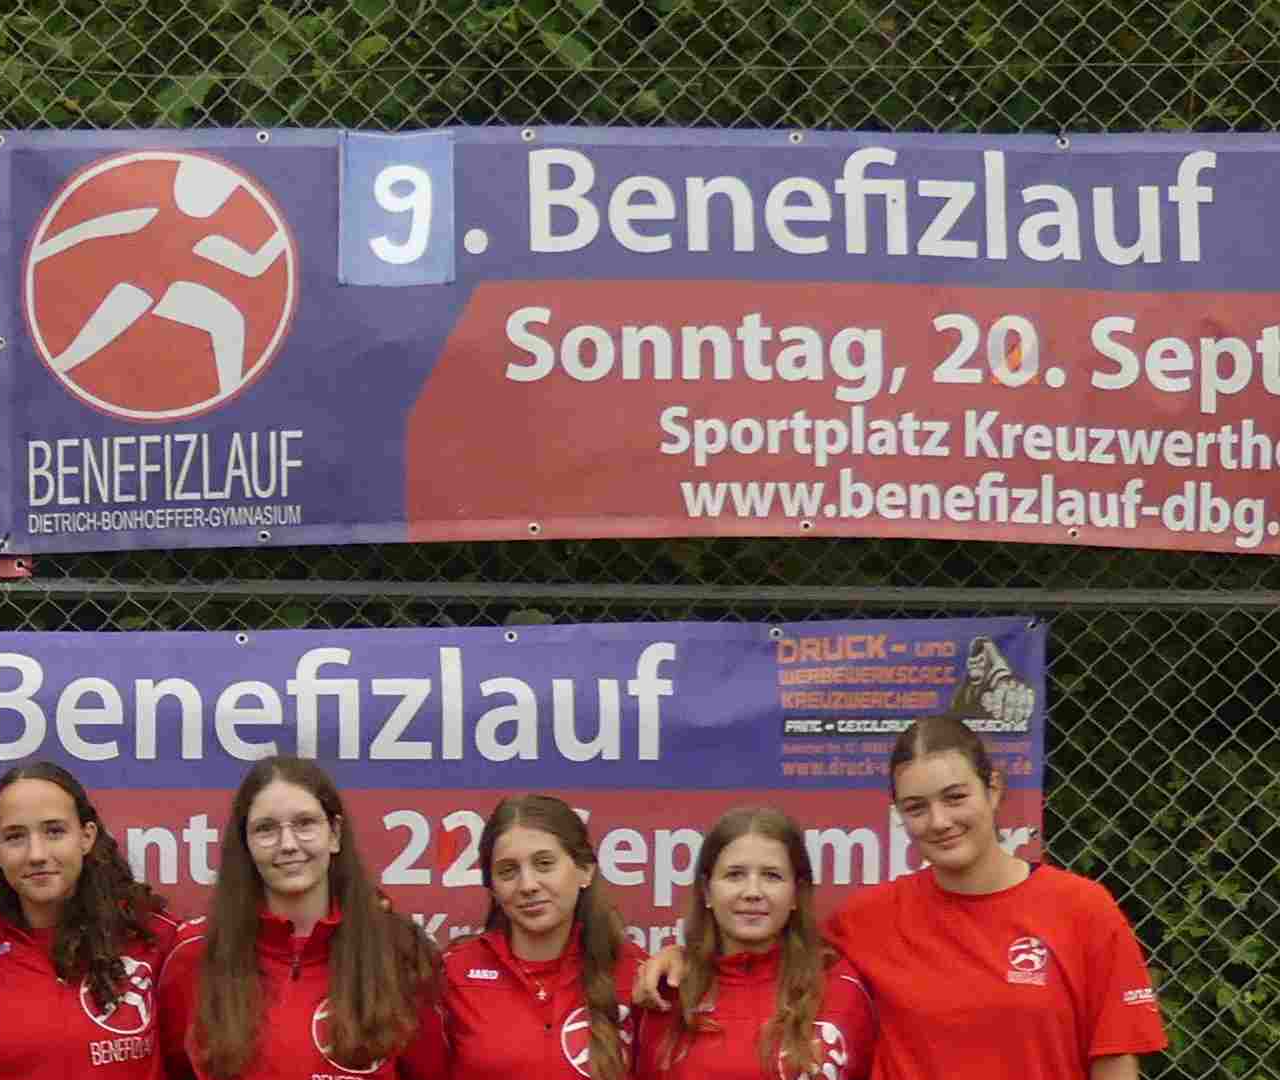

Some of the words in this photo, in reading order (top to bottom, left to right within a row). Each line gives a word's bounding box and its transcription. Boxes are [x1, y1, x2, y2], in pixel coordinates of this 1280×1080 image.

[369, 164, 488, 265] 9.
[527, 146, 1217, 266] Benefizlauf
[504, 306, 906, 403] Sonntag,
[932, 312, 1067, 390] 20.
[28, 430, 303, 507] BENEFIZLAUF
[659, 405, 950, 467] Sportplatz
[964, 409, 1280, 471] Kreuzwerth
[28, 504, 302, 534] DIETRICH-BONHOEFFER-GYMNASIUM
